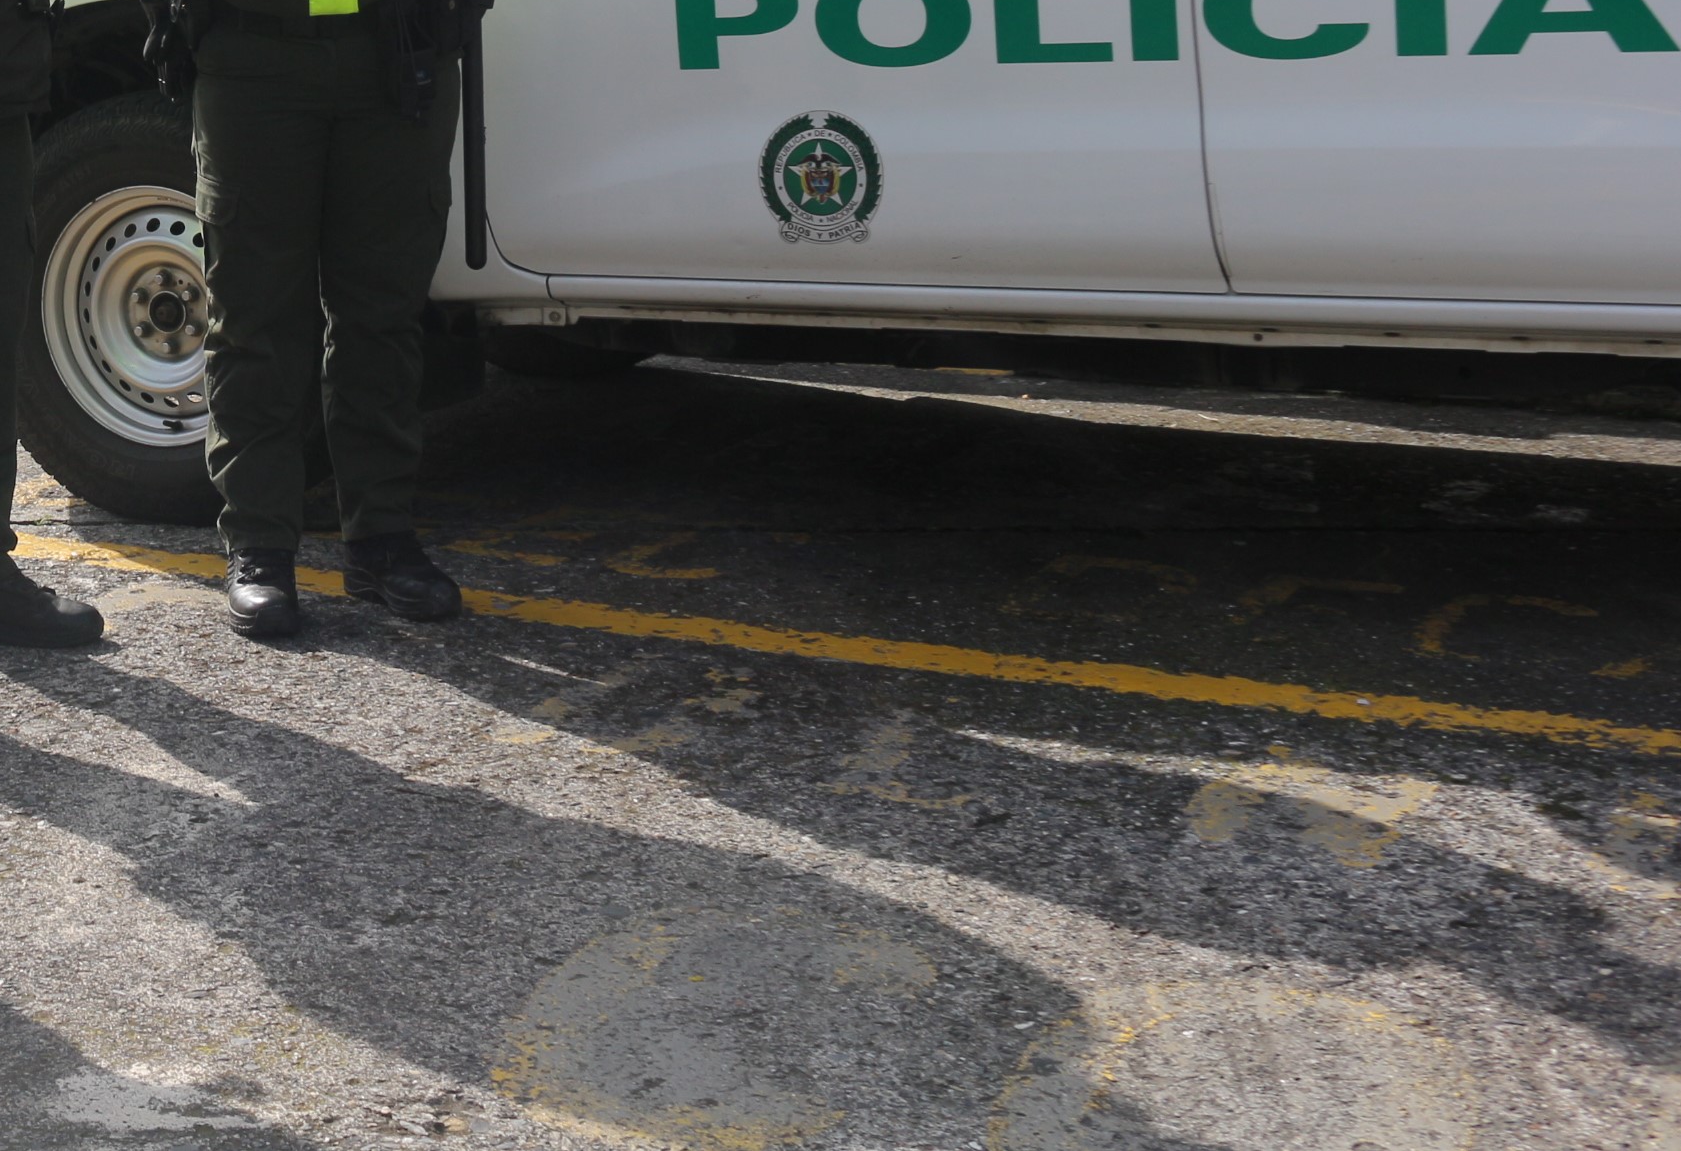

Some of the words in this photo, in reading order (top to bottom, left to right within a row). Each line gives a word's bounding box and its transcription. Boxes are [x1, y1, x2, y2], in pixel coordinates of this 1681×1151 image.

[834, 134, 864, 172] COLOMBIA
[826, 200, 858, 222] NACIONAL
[787, 222, 811, 237] DIOS
[828, 222, 861, 239] PATRIA
